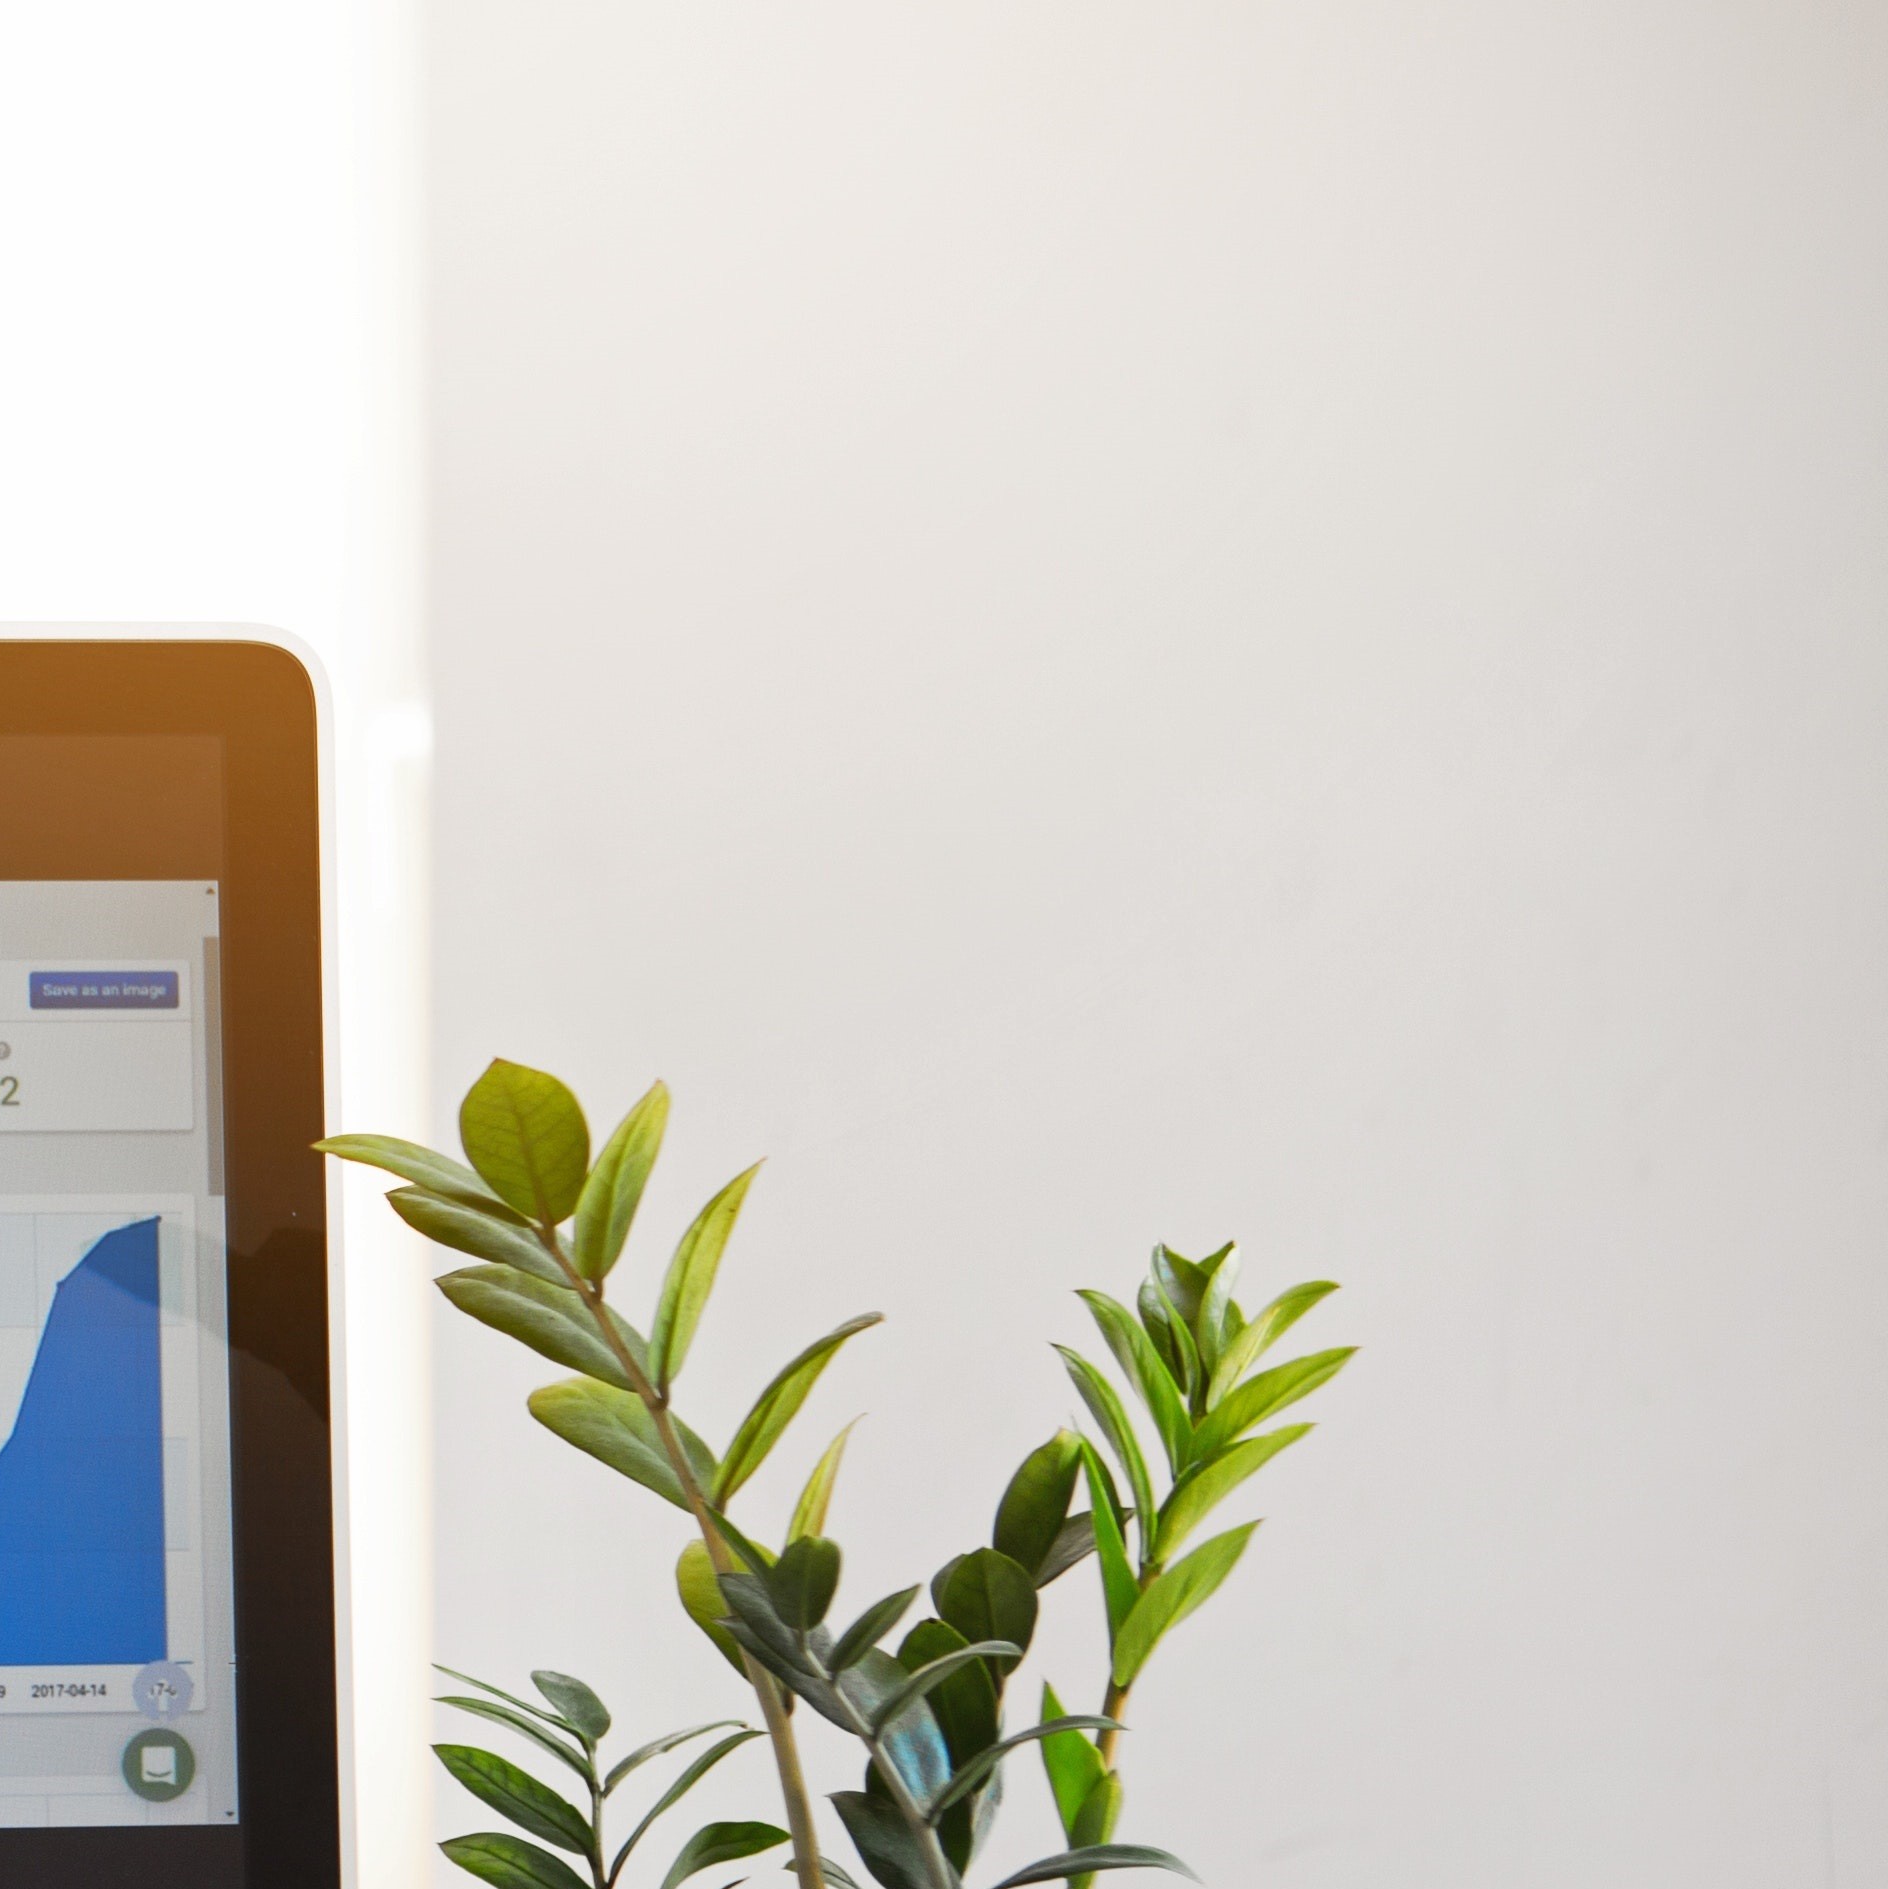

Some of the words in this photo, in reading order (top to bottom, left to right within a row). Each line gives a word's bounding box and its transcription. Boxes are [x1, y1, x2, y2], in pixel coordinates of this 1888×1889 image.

[42, 983, 78, 997] Save
[81, 986, 98, 996] as
[101, 986, 120, 996] an
[123, 983, 167, 1000] image
[31, 1684, 106, 1698] 2017-04-14
